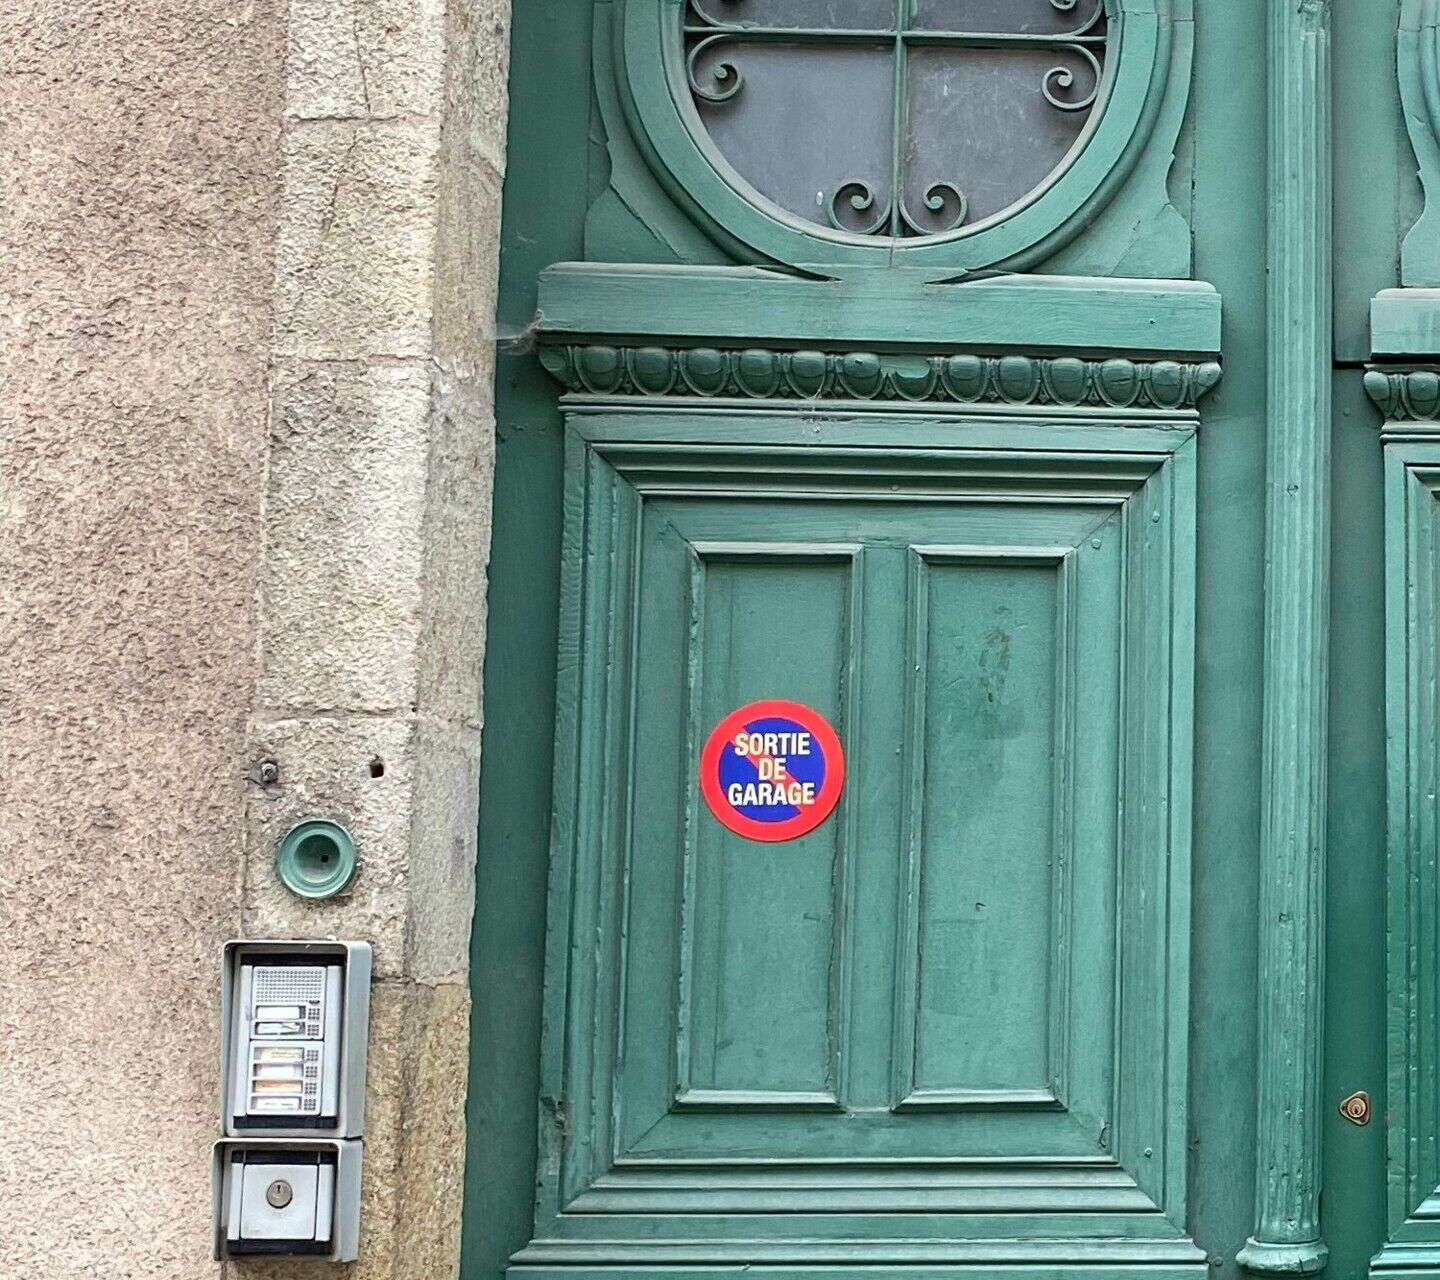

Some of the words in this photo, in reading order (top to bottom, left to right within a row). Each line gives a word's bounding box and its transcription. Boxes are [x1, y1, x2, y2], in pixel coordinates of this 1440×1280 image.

[735, 732, 811, 756] SORTIE
[758, 757, 787, 780] DE
[728, 782, 815, 806] GARAGE
